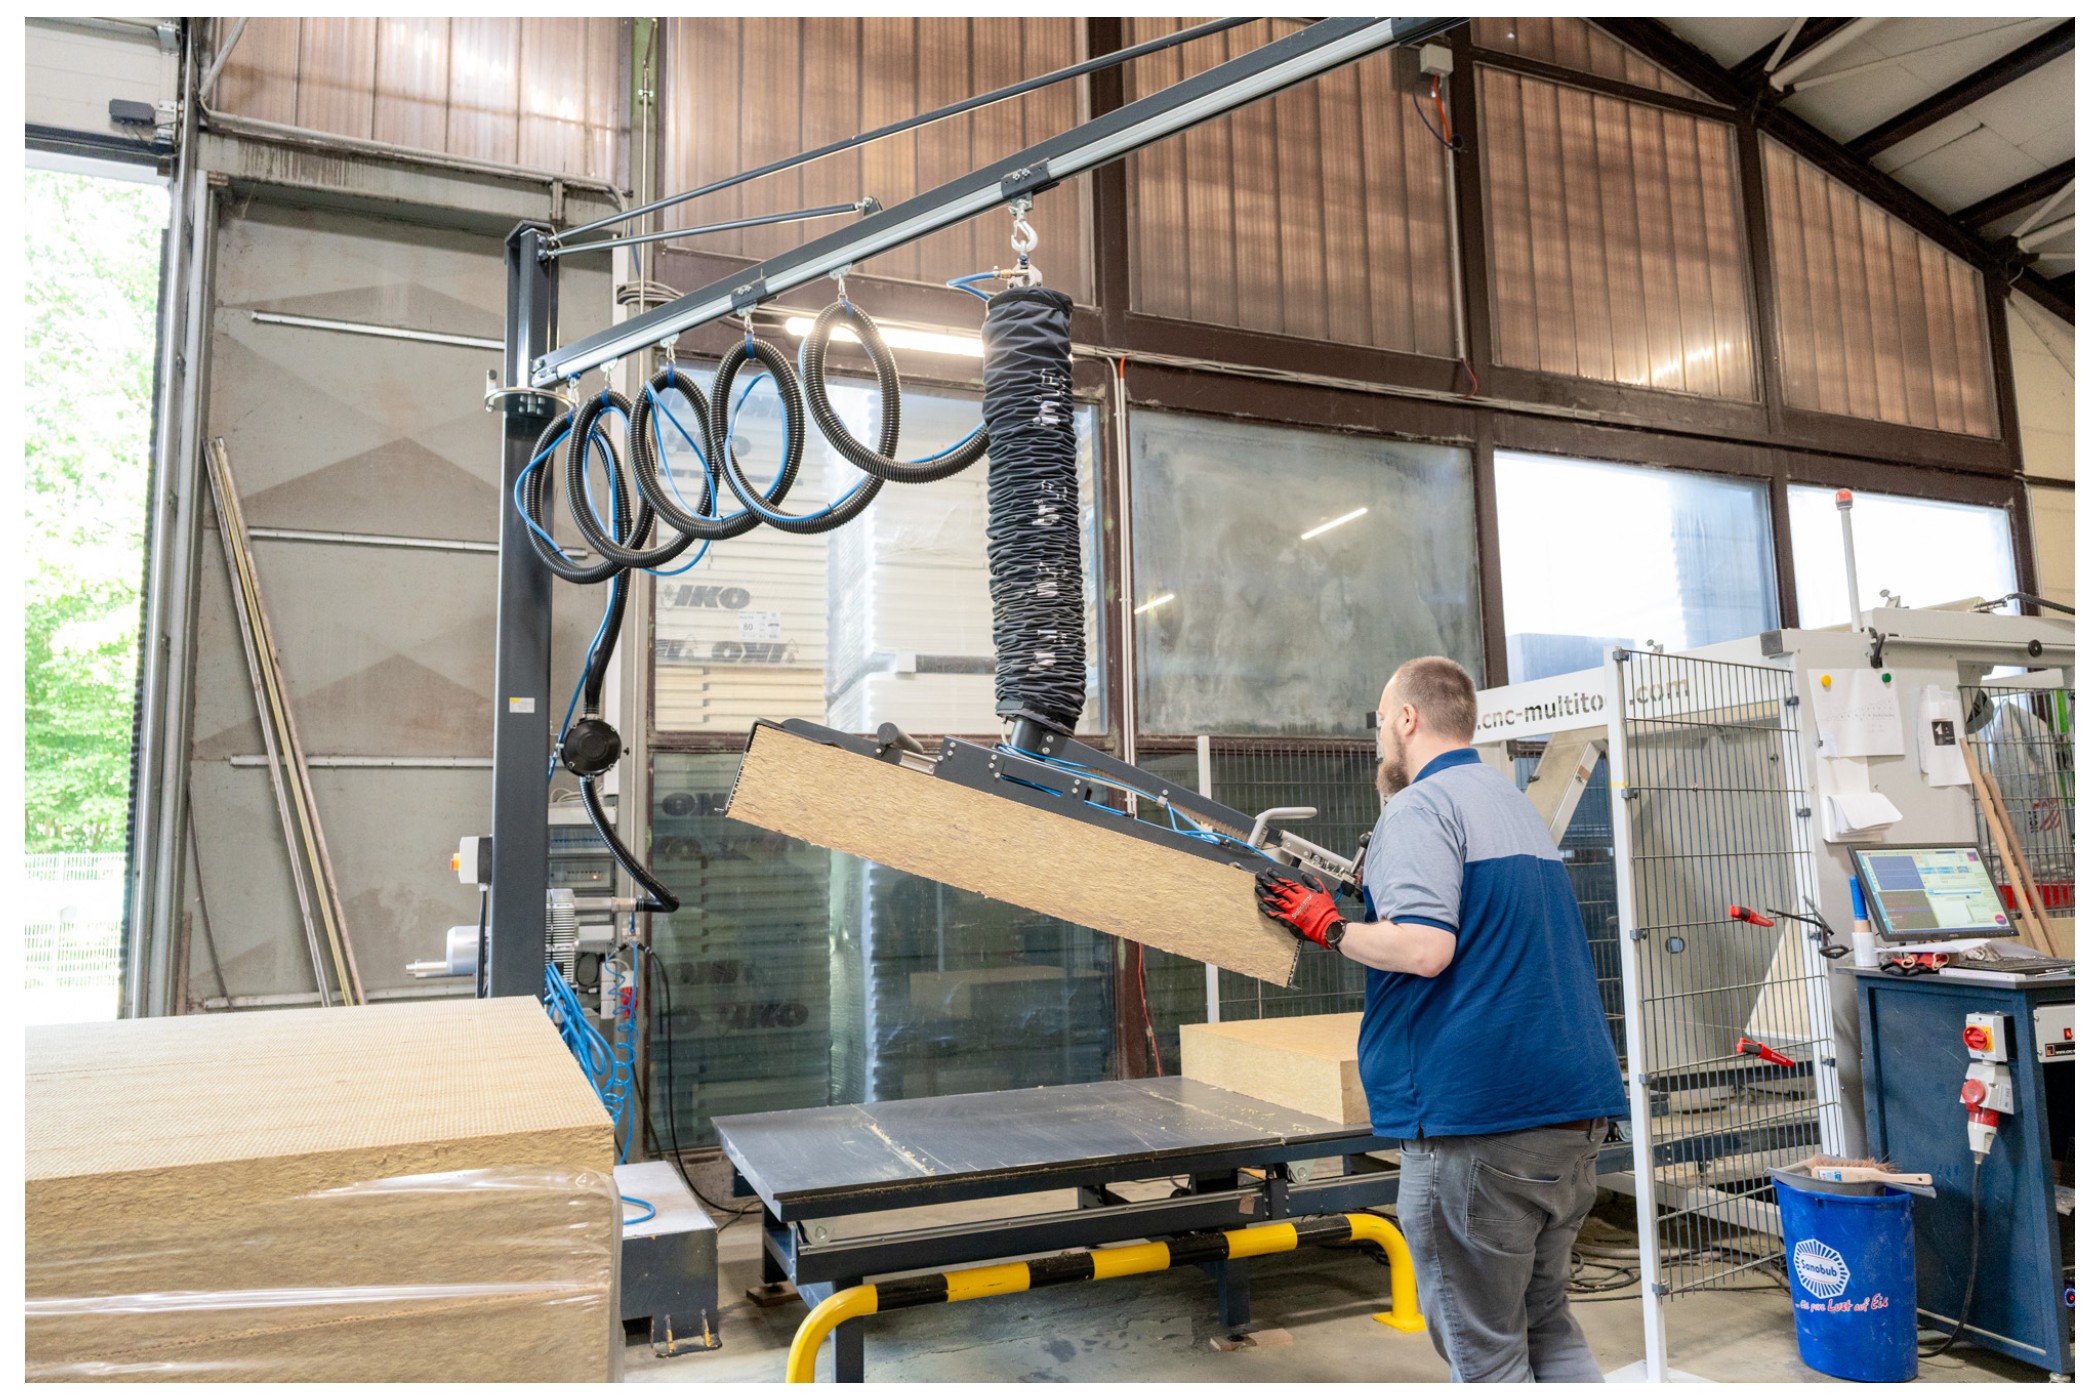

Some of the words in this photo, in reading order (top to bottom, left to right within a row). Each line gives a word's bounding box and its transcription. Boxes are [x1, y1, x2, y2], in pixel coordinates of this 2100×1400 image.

[674, 584, 751, 609] IKO
[1800, 1259, 1838, 1278] Sanobub
[1827, 1298, 1853, 1312] Lust
[1854, 1297, 1870, 1312] auf
[1871, 1293, 1888, 1309] Eis
